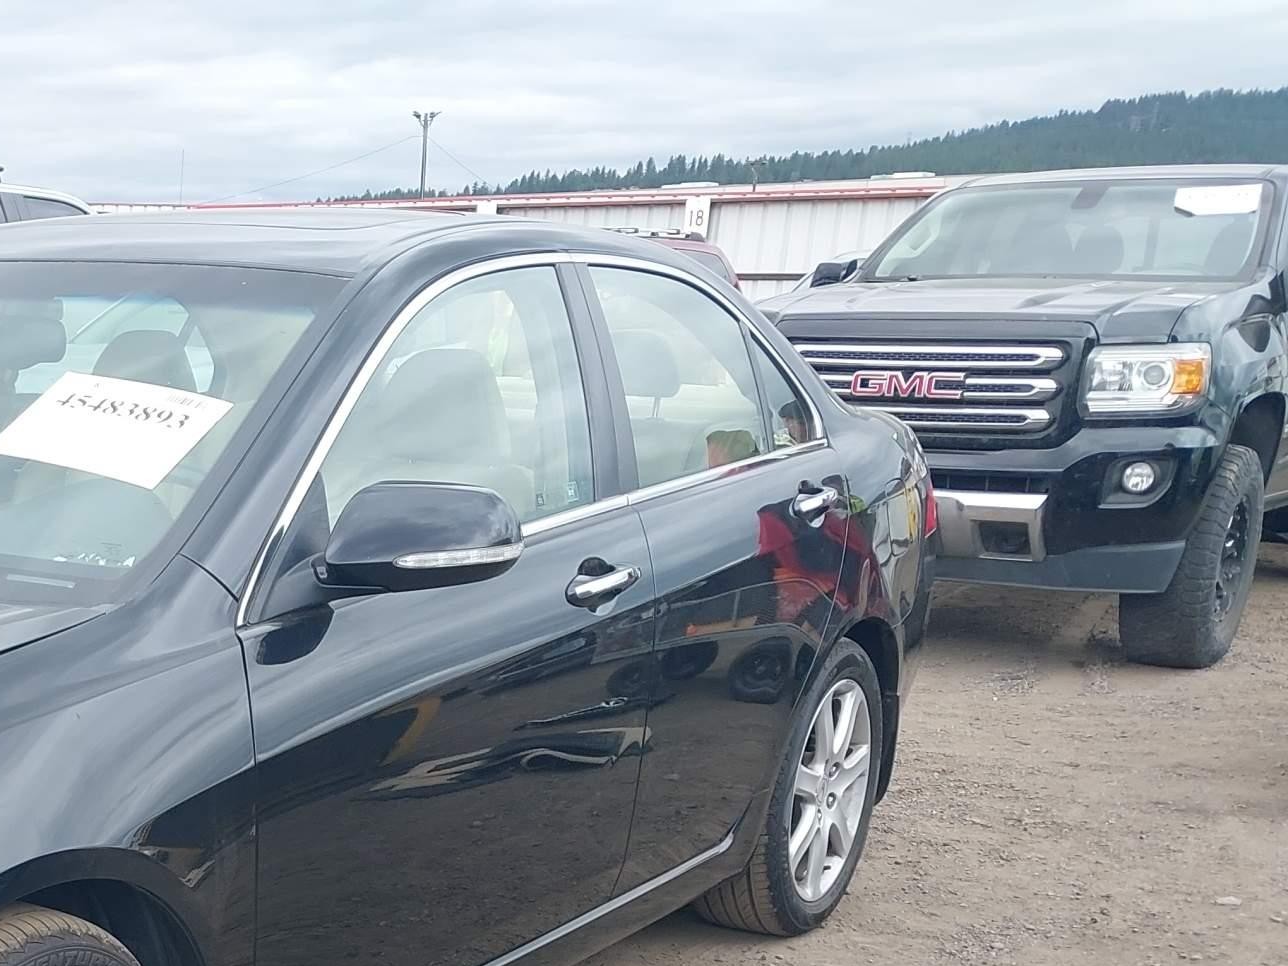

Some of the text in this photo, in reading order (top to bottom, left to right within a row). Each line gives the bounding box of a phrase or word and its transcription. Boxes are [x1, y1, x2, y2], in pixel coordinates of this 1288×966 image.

[688, 209, 704, 227] 18
[850, 370, 965, 399] GMC
[56, 393, 191, 430] 45483893
